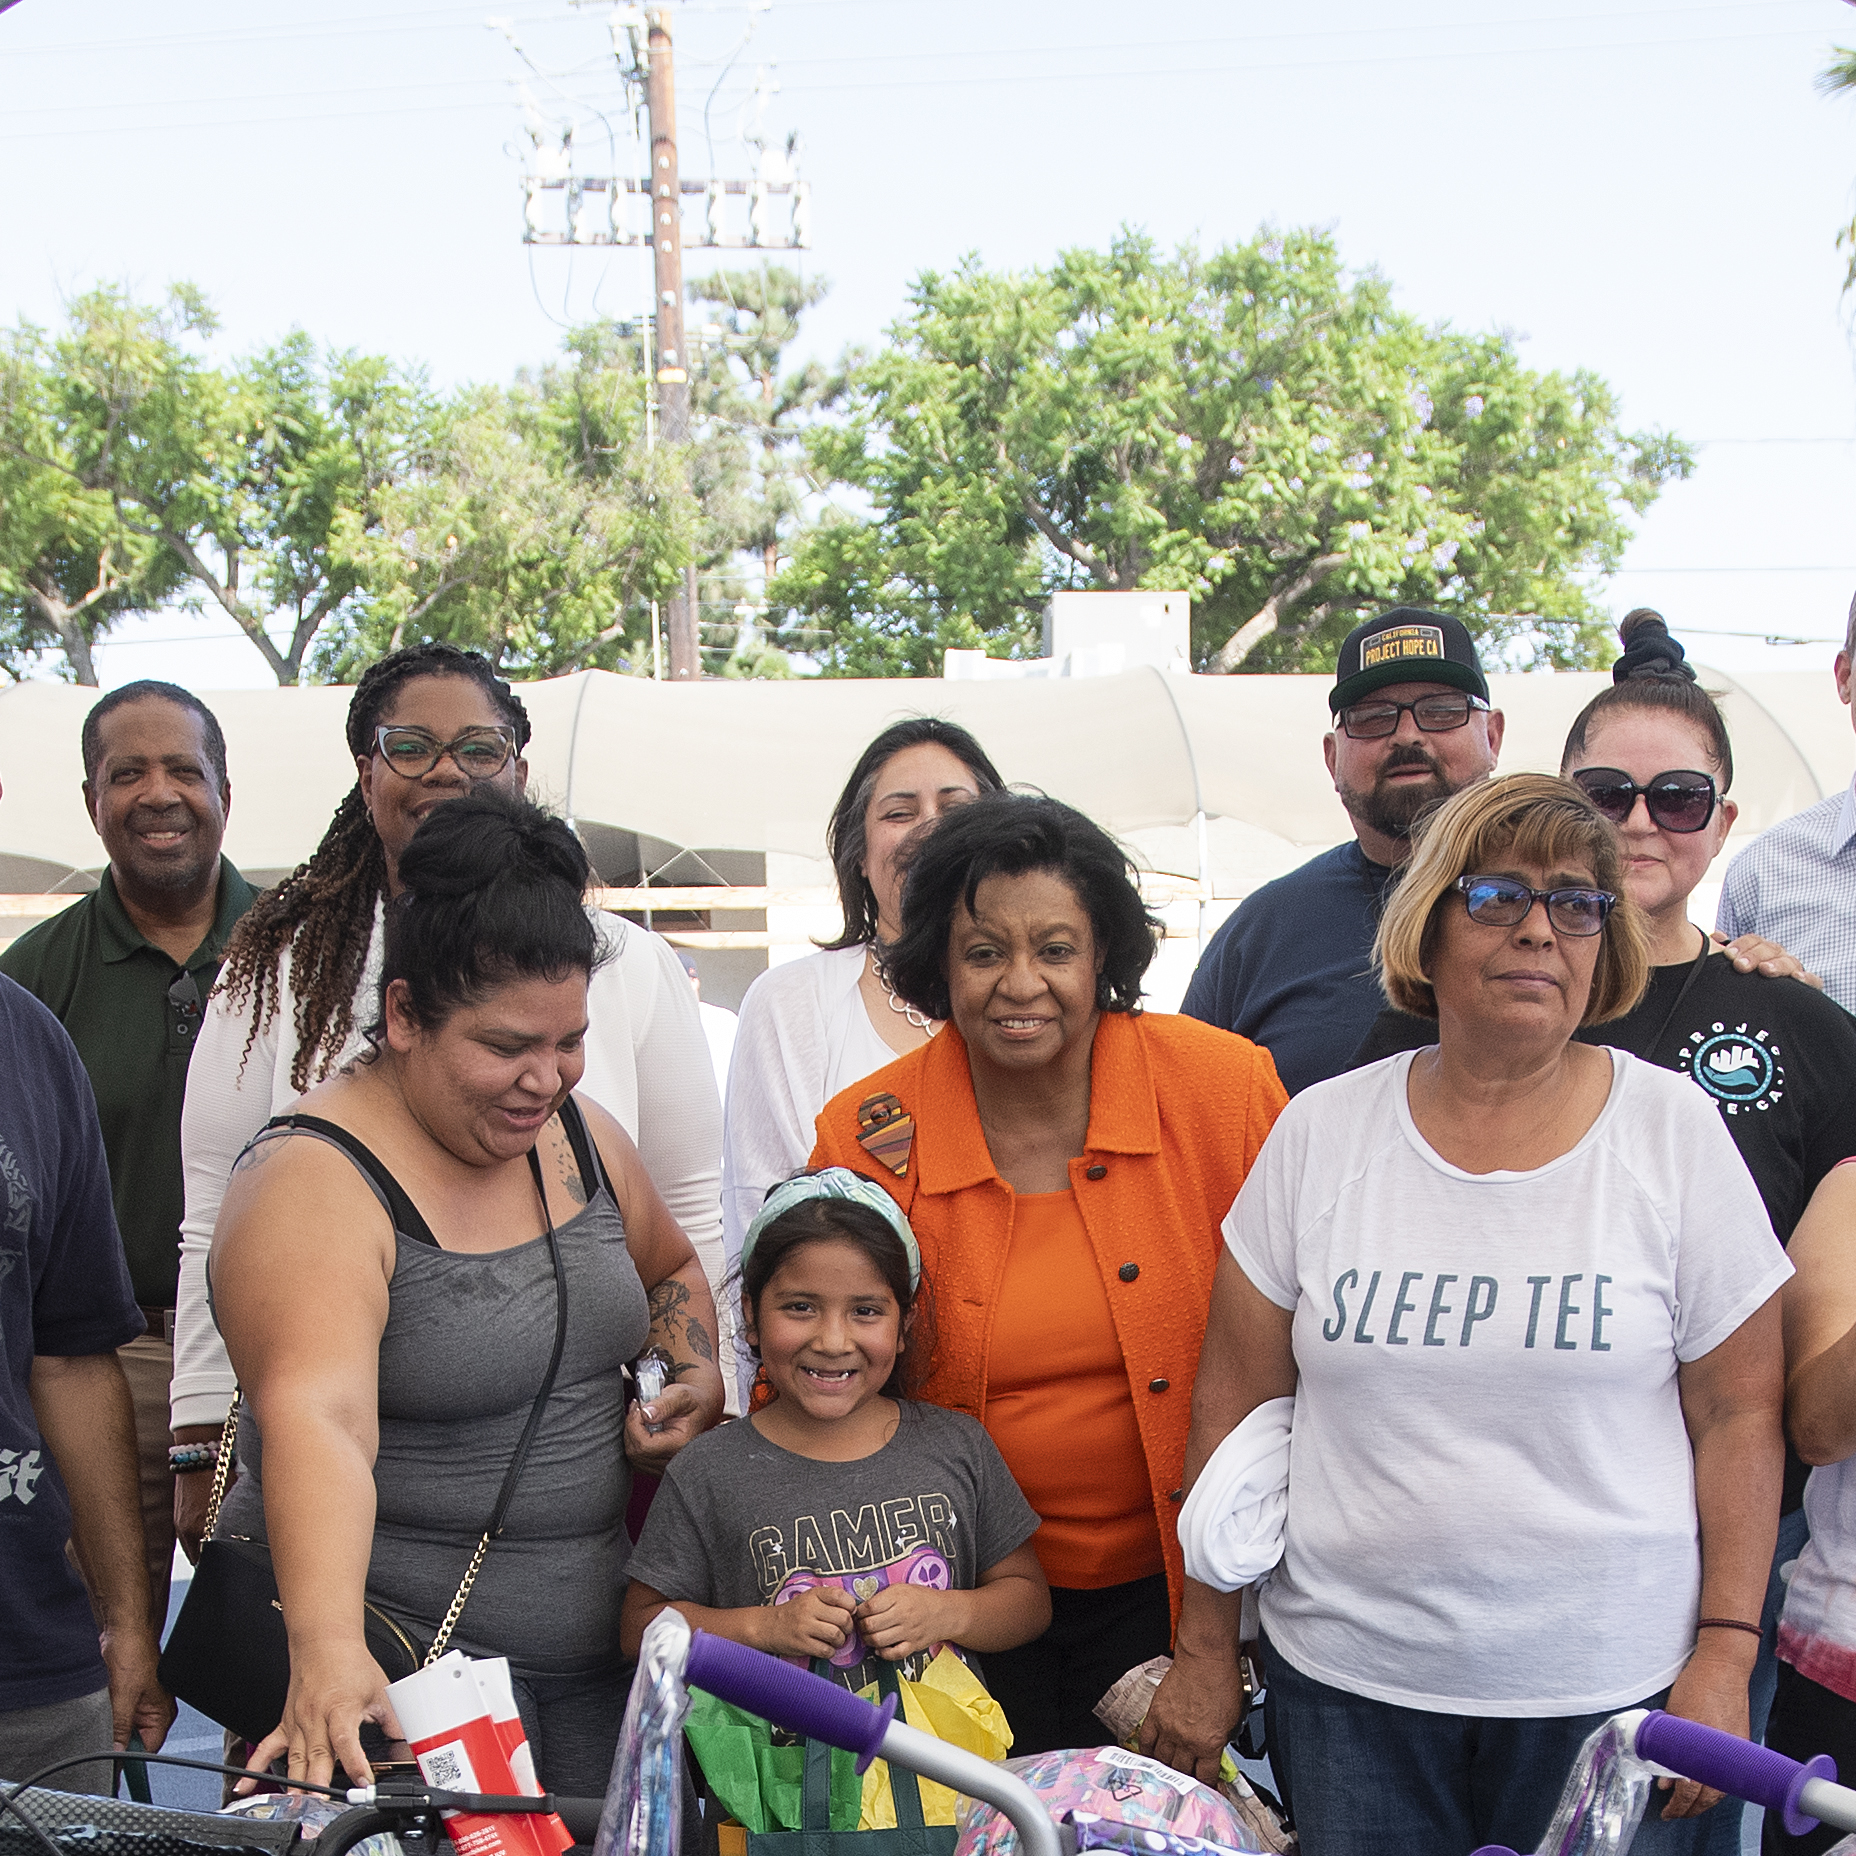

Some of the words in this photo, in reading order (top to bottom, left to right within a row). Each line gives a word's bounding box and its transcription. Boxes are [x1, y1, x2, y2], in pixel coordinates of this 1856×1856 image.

[1365, 639, 1401, 667] PROJECT
[1402, 638, 1425, 656] HOPE
[1426, 639, 1439, 656] CA
[1322, 1268, 1499, 1347] SLEEP
[1524, 1273, 1614, 1352] TEE
[748, 1492, 957, 1600] GAMER
